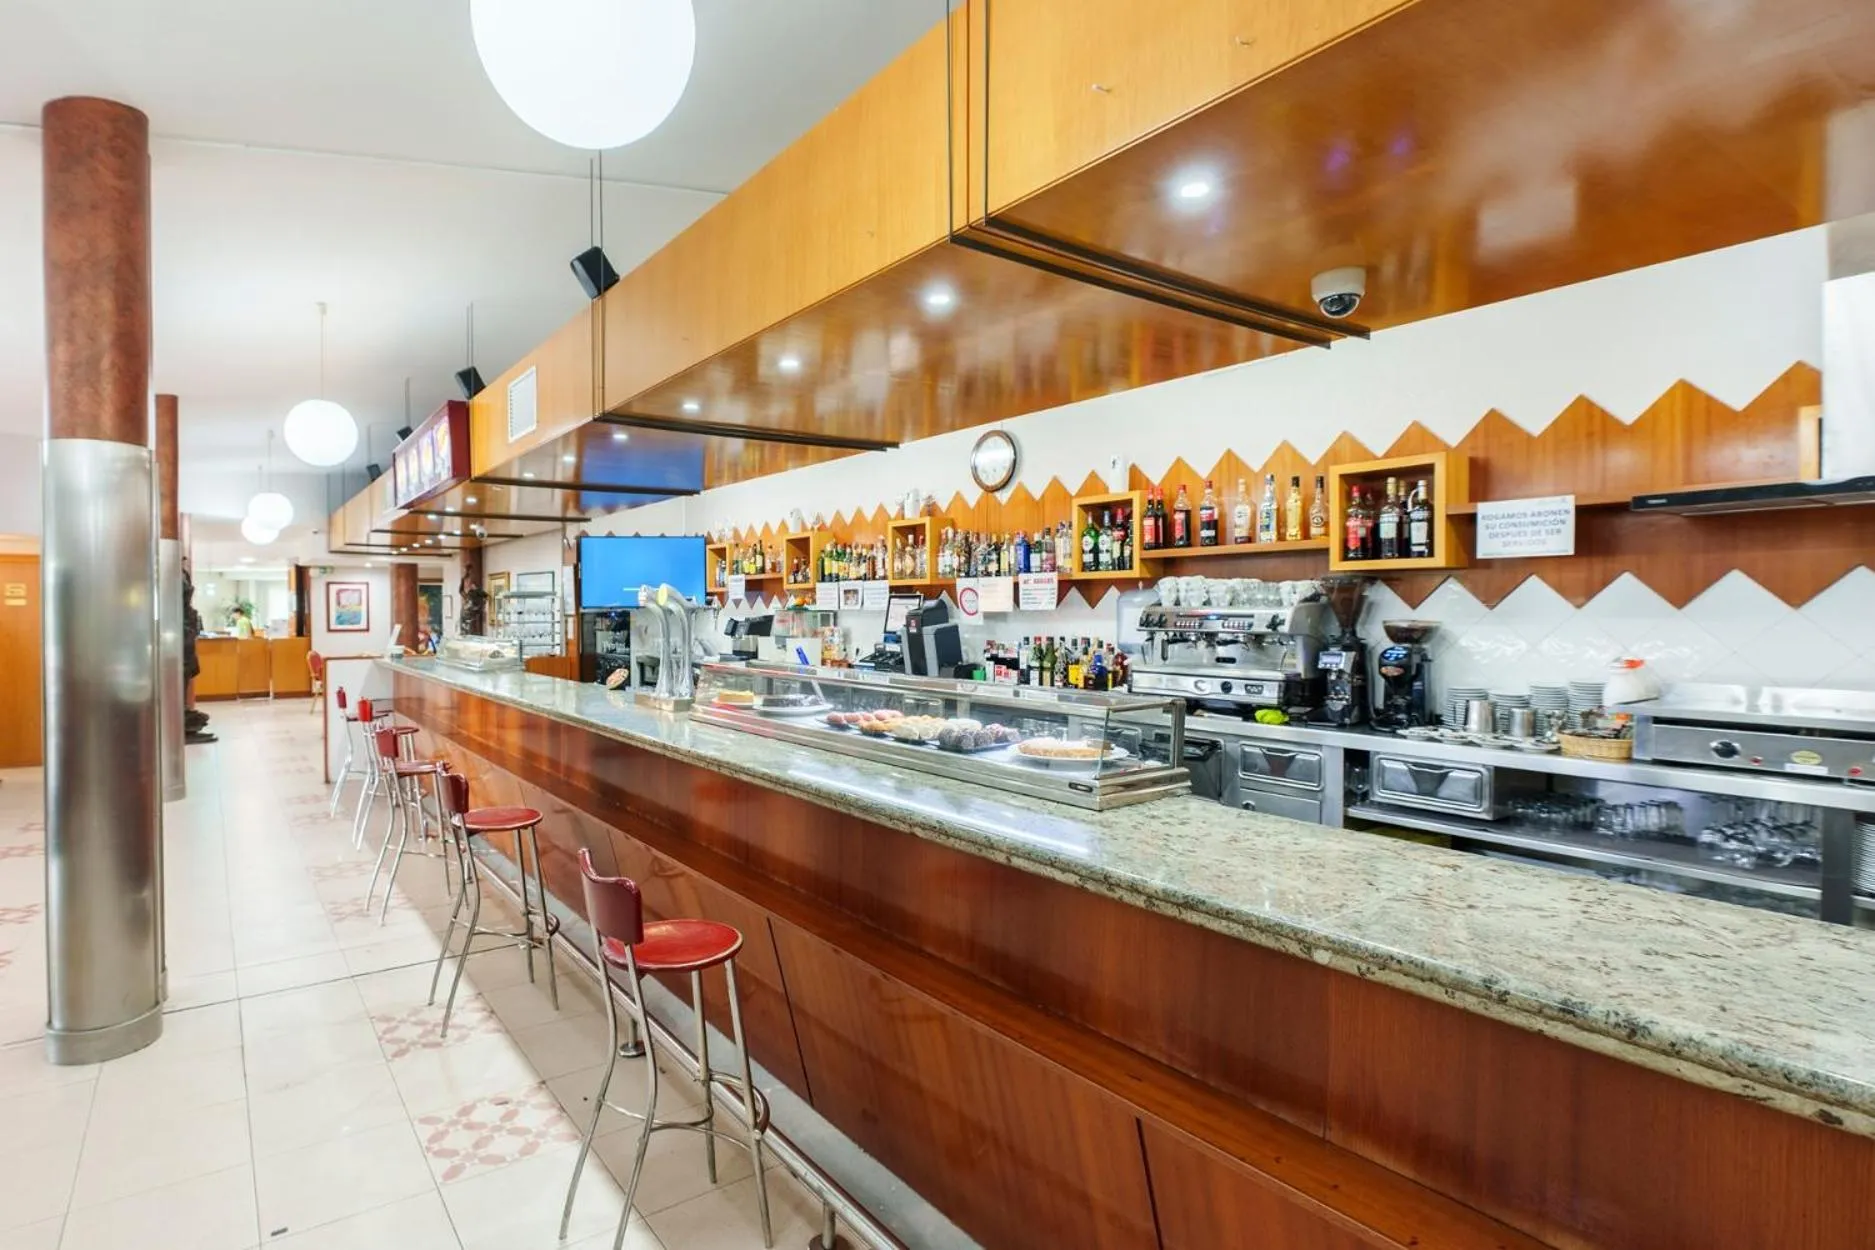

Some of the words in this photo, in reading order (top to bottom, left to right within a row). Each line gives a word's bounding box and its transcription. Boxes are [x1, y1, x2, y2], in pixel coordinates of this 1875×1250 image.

[1530, 509, 1571, 518] ABONEN
[1485, 522, 1497, 530] SU
[1530, 529, 1542, 537] DE
[1544, 528, 1562, 536] SER
